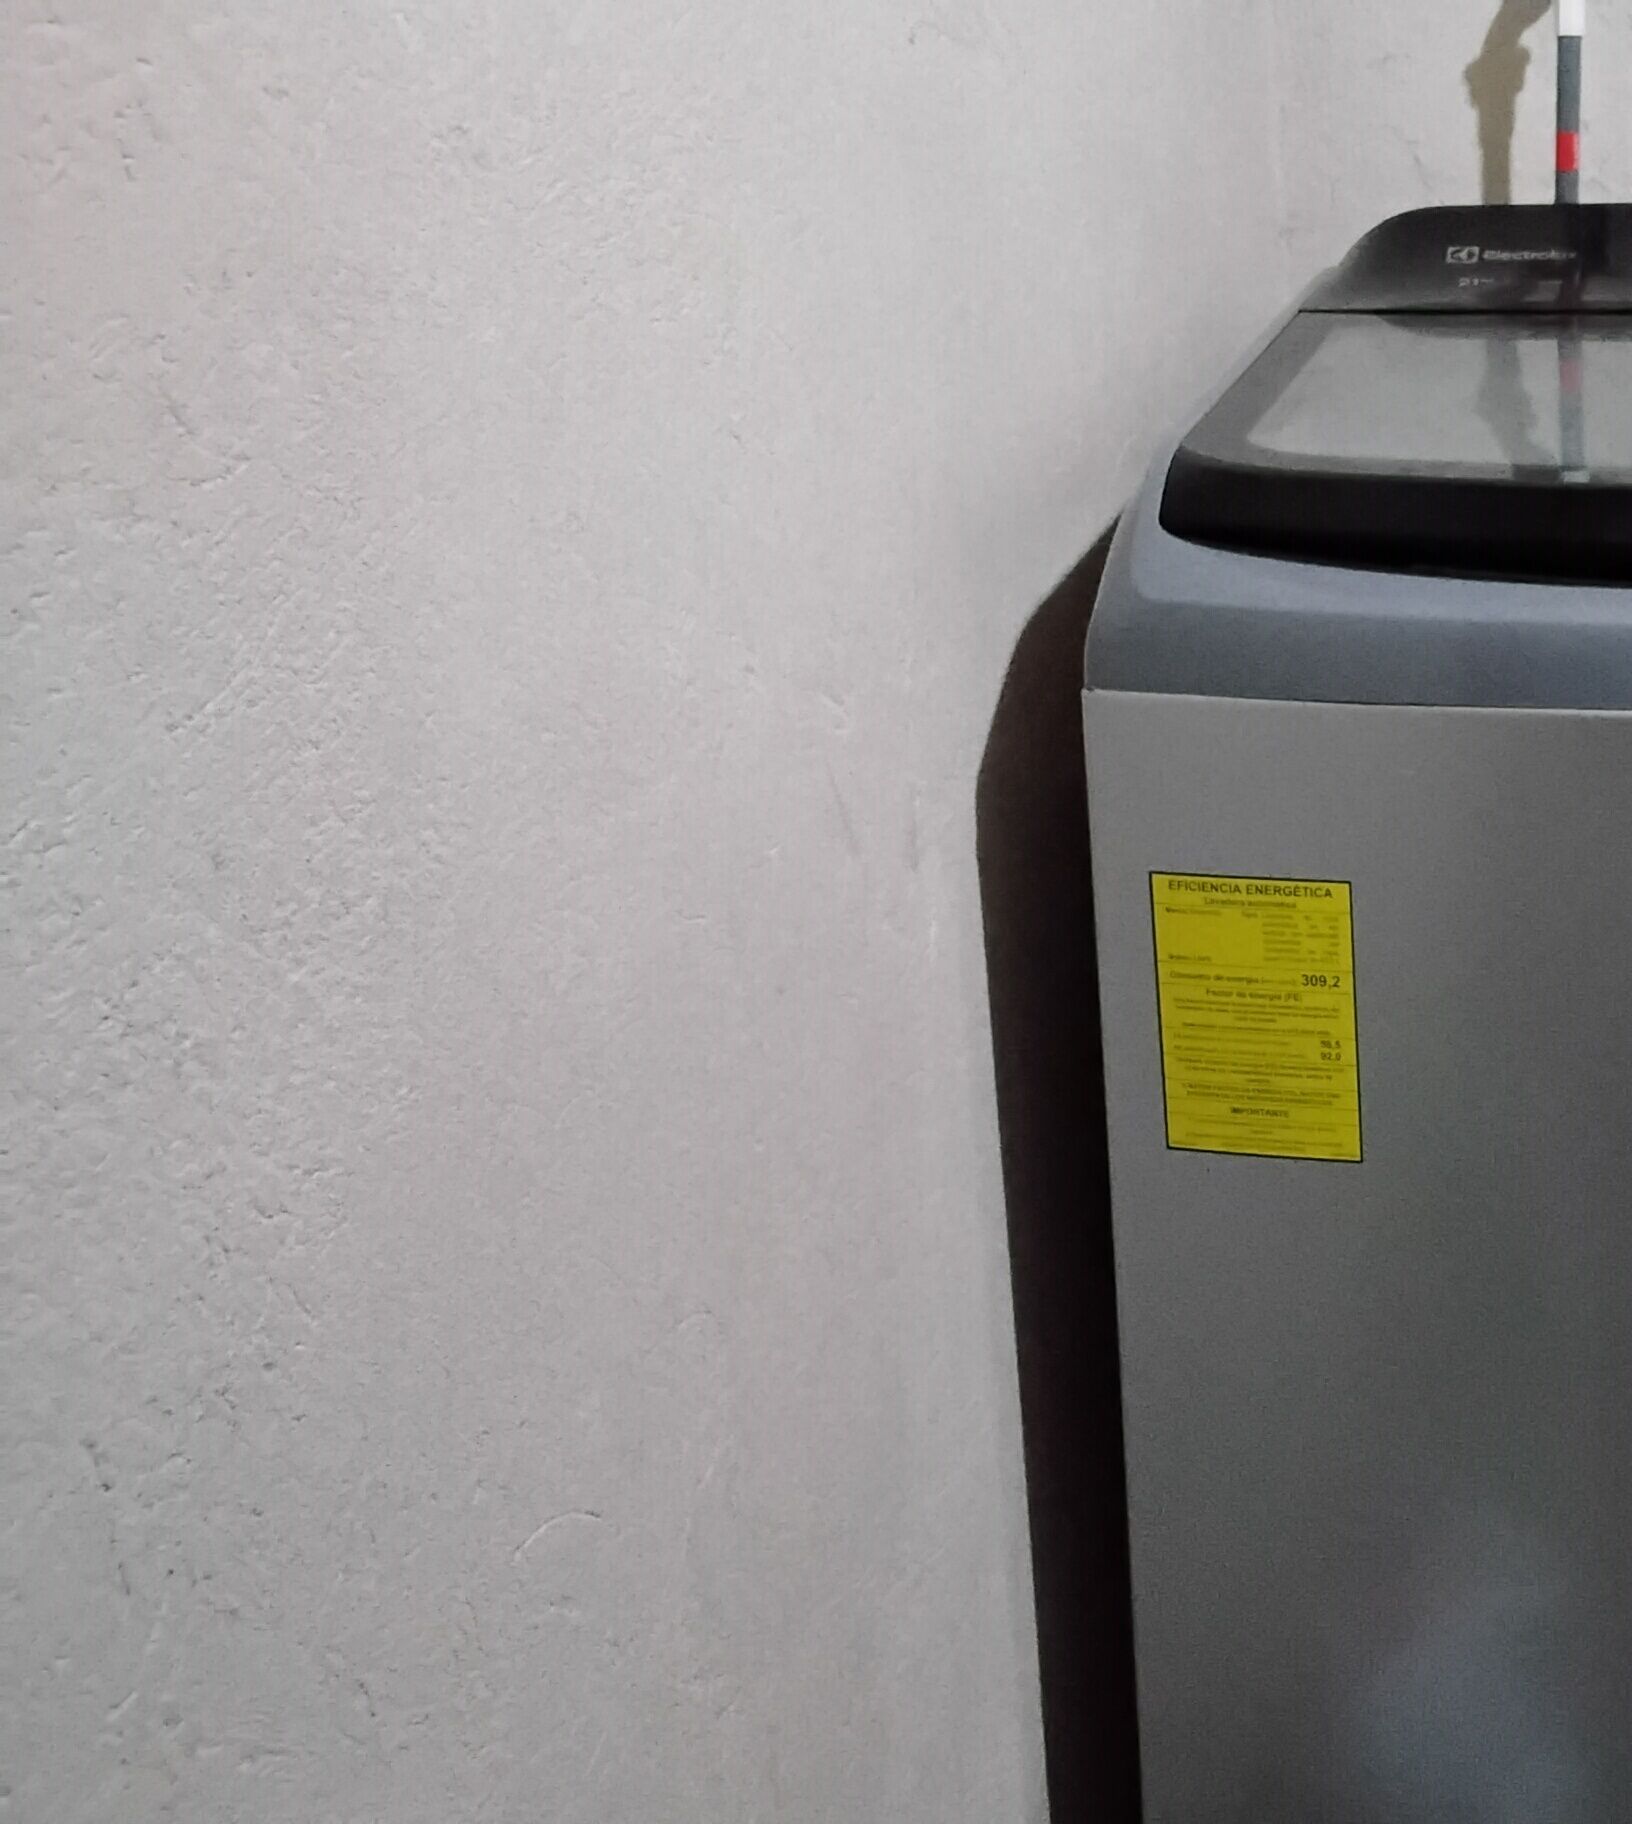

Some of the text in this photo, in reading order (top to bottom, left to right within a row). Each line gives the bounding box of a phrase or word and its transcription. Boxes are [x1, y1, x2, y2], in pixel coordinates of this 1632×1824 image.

[1483, 249, 1577, 261] Electrolux
[1168, 880, 1333, 899] EFICIENCIA ENERGÉTICA
